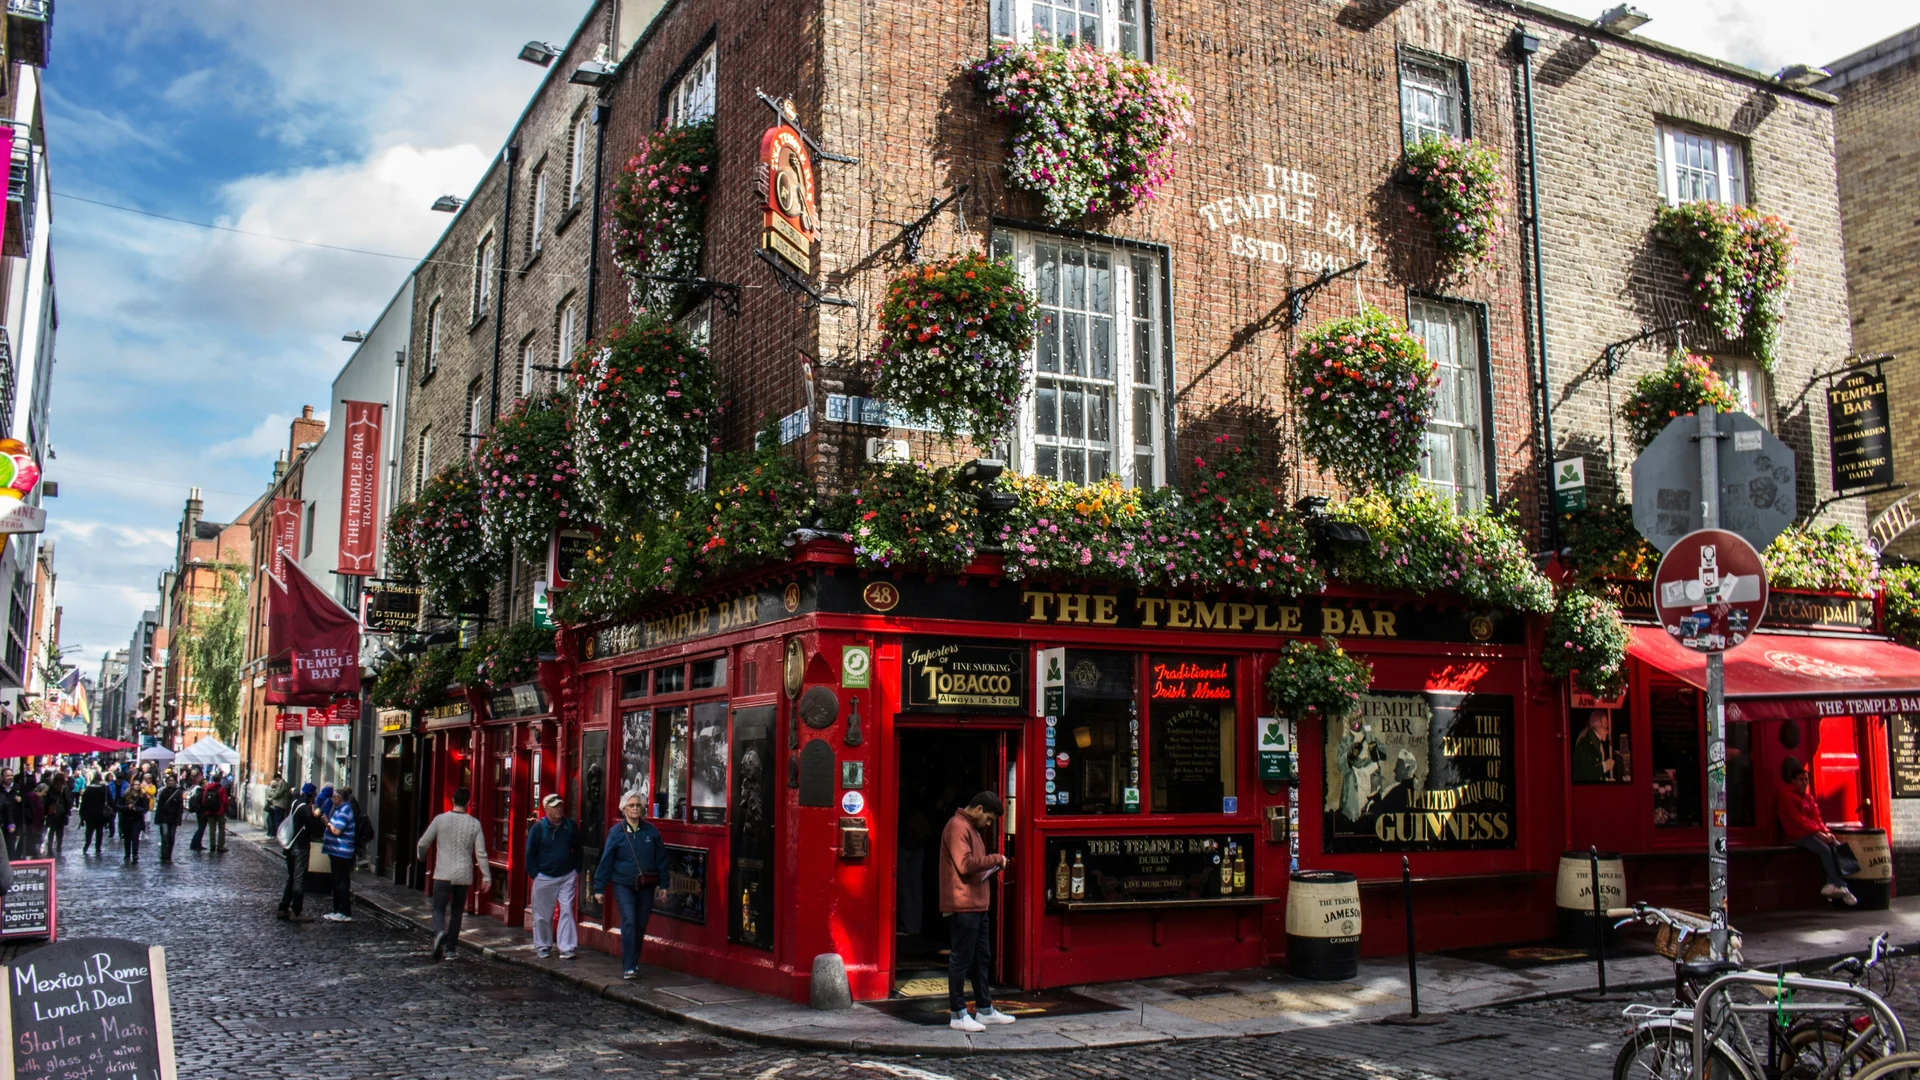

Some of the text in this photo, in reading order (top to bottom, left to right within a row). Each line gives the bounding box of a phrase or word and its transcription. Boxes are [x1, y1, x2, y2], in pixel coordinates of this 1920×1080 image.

[1262, 163, 1317, 198] THE
[1199, 194, 1378, 263] TEMPLE BAR
[1231, 234, 1347, 273] ESTD. 1840
[1846, 376, 1865, 387] THE
[1829, 382, 1884, 404] TEMPLE
[1843, 400, 1872, 416] BAR
[1834, 426, 1886, 443] BEER GARDEN
[1837, 457, 1886, 473] LIVE MUSIC
[1849, 469, 1875, 481] DAILY
[347, 432, 364, 546] THE TEMPLE BAR
[363, 453, 374, 528] TRADING CO.
[285, 520, 294, 540] THE
[1873, 499, 1916, 546] THE
[870, 586, 892, 603] 48
[646, 605, 710, 646] TEMPLE
[718, 594, 759, 629] BAR
[1023, 591, 1397, 637] THE TEMPLE BAR
[312, 648, 337, 657] THE
[907, 644, 959, 666] Importers
[296, 655, 353, 669] TEMPLE
[953, 662, 1011, 672] FINE SMOKING
[311, 668, 341, 680] BAR
[1154, 663, 1227, 680] Traditional
[921, 666, 1011, 700] TOBACCO
[1152, 681, 1230, 699] Irish Music
[939, 695, 1018, 705] Always in Stock
[1816, 700, 1844, 715] THE
[1846, 698, 1898, 714] TEMPLE
[1167, 709, 1219, 728] TEMPLE BAR
[1364, 701, 1426, 718] TEMPLE
[1381, 718, 1412, 734] BAR
[1475, 715, 1500, 734] THE
[1443, 736, 1500, 756] EMPEROR
[1487, 760, 1500, 777] OF
[1407, 780, 1507, 810] MALTED LIQUORS
[1376, 812, 1509, 841] GUINNESS
[1088, 840, 1120, 855] THE
[1124, 839, 1184, 855] TEMPLE
[1139, 855, 1170, 865] DUBLIN
[1124, 879, 1183, 889] LIVE MUSIC DAILY
[1579, 885, 1621, 897] JAESON
[1319, 899, 1333, 907] THE
[5, 912, 45, 922] DONUTS
[15, 953, 149, 996] Mexico to Rome
[34, 984, 133, 1021] Lunch Deal
[20, 1026, 82, 1055] Starter
[101, 1016, 149, 1042] Main
[17, 1045, 142, 1073] with glass of wine
[64, 1064, 95, 1080] soft
[105, 1061, 137, 1074] drink
